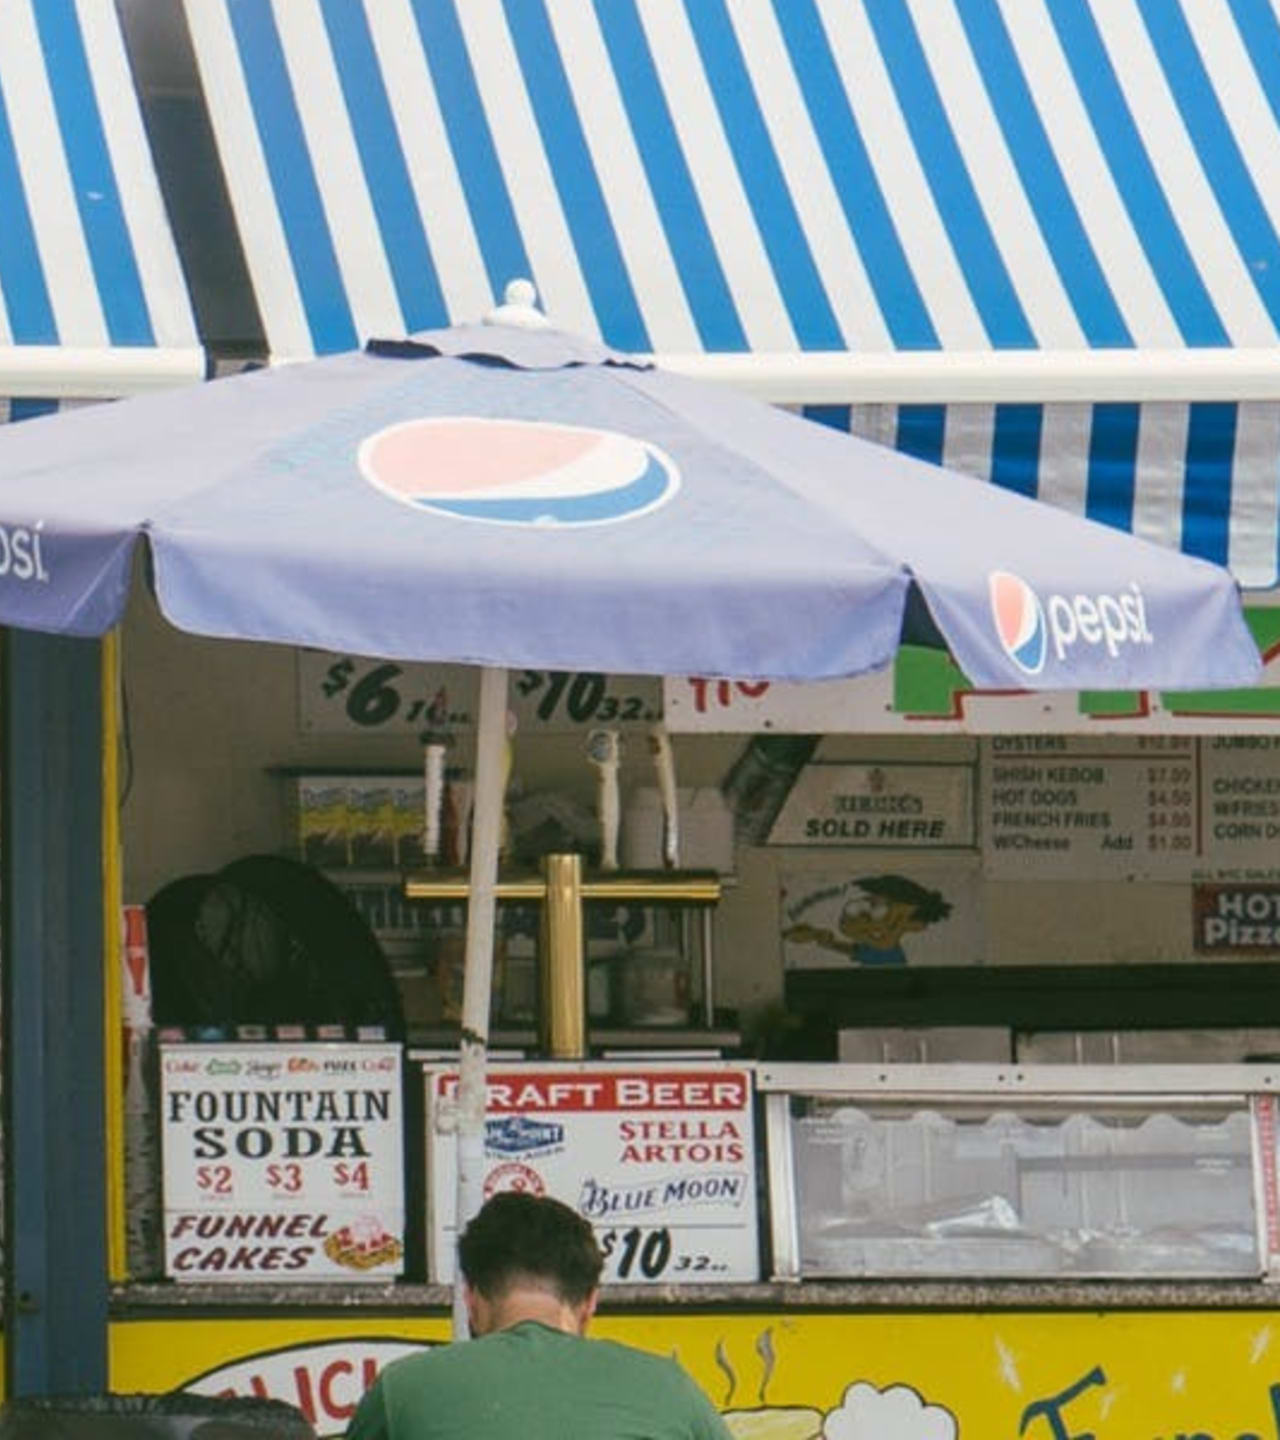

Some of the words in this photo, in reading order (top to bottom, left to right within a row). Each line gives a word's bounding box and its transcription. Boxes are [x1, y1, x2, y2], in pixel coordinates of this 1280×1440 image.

[1048, 584, 1154, 660] pepsi
[320, 657, 403, 726] $6
[992, 788, 1025, 806] HOT
[1029, 788, 1079, 806] DOGS
[805, 817, 871, 839] SOLD
[877, 818, 946, 839] HERE
[992, 811, 1062, 828] FRENCH
[1063, 811, 1112, 828] FRIES
[1213, 822, 1262, 840] CORN
[1100, 833, 1134, 851] Add
[614, 1077, 742, 1106] BEER
[167, 1090, 391, 1123] FOUNTAIN
[192, 1126, 372, 1159] SODA
[619, 1121, 740, 1140] STELLA
[620, 1144, 744, 1164] ARTOIS
[197, 1164, 232, 1194] $2
[266, 1162, 303, 1192] $3
[333, 1161, 369, 1191] $4
[582, 1184, 656, 1217] BLUE
[663, 1178, 740, 1204] MOON
[170, 1213, 329, 1239] FUNNEL
[172, 1246, 316, 1271] CAKES
[602, 1226, 671, 1279] $10
